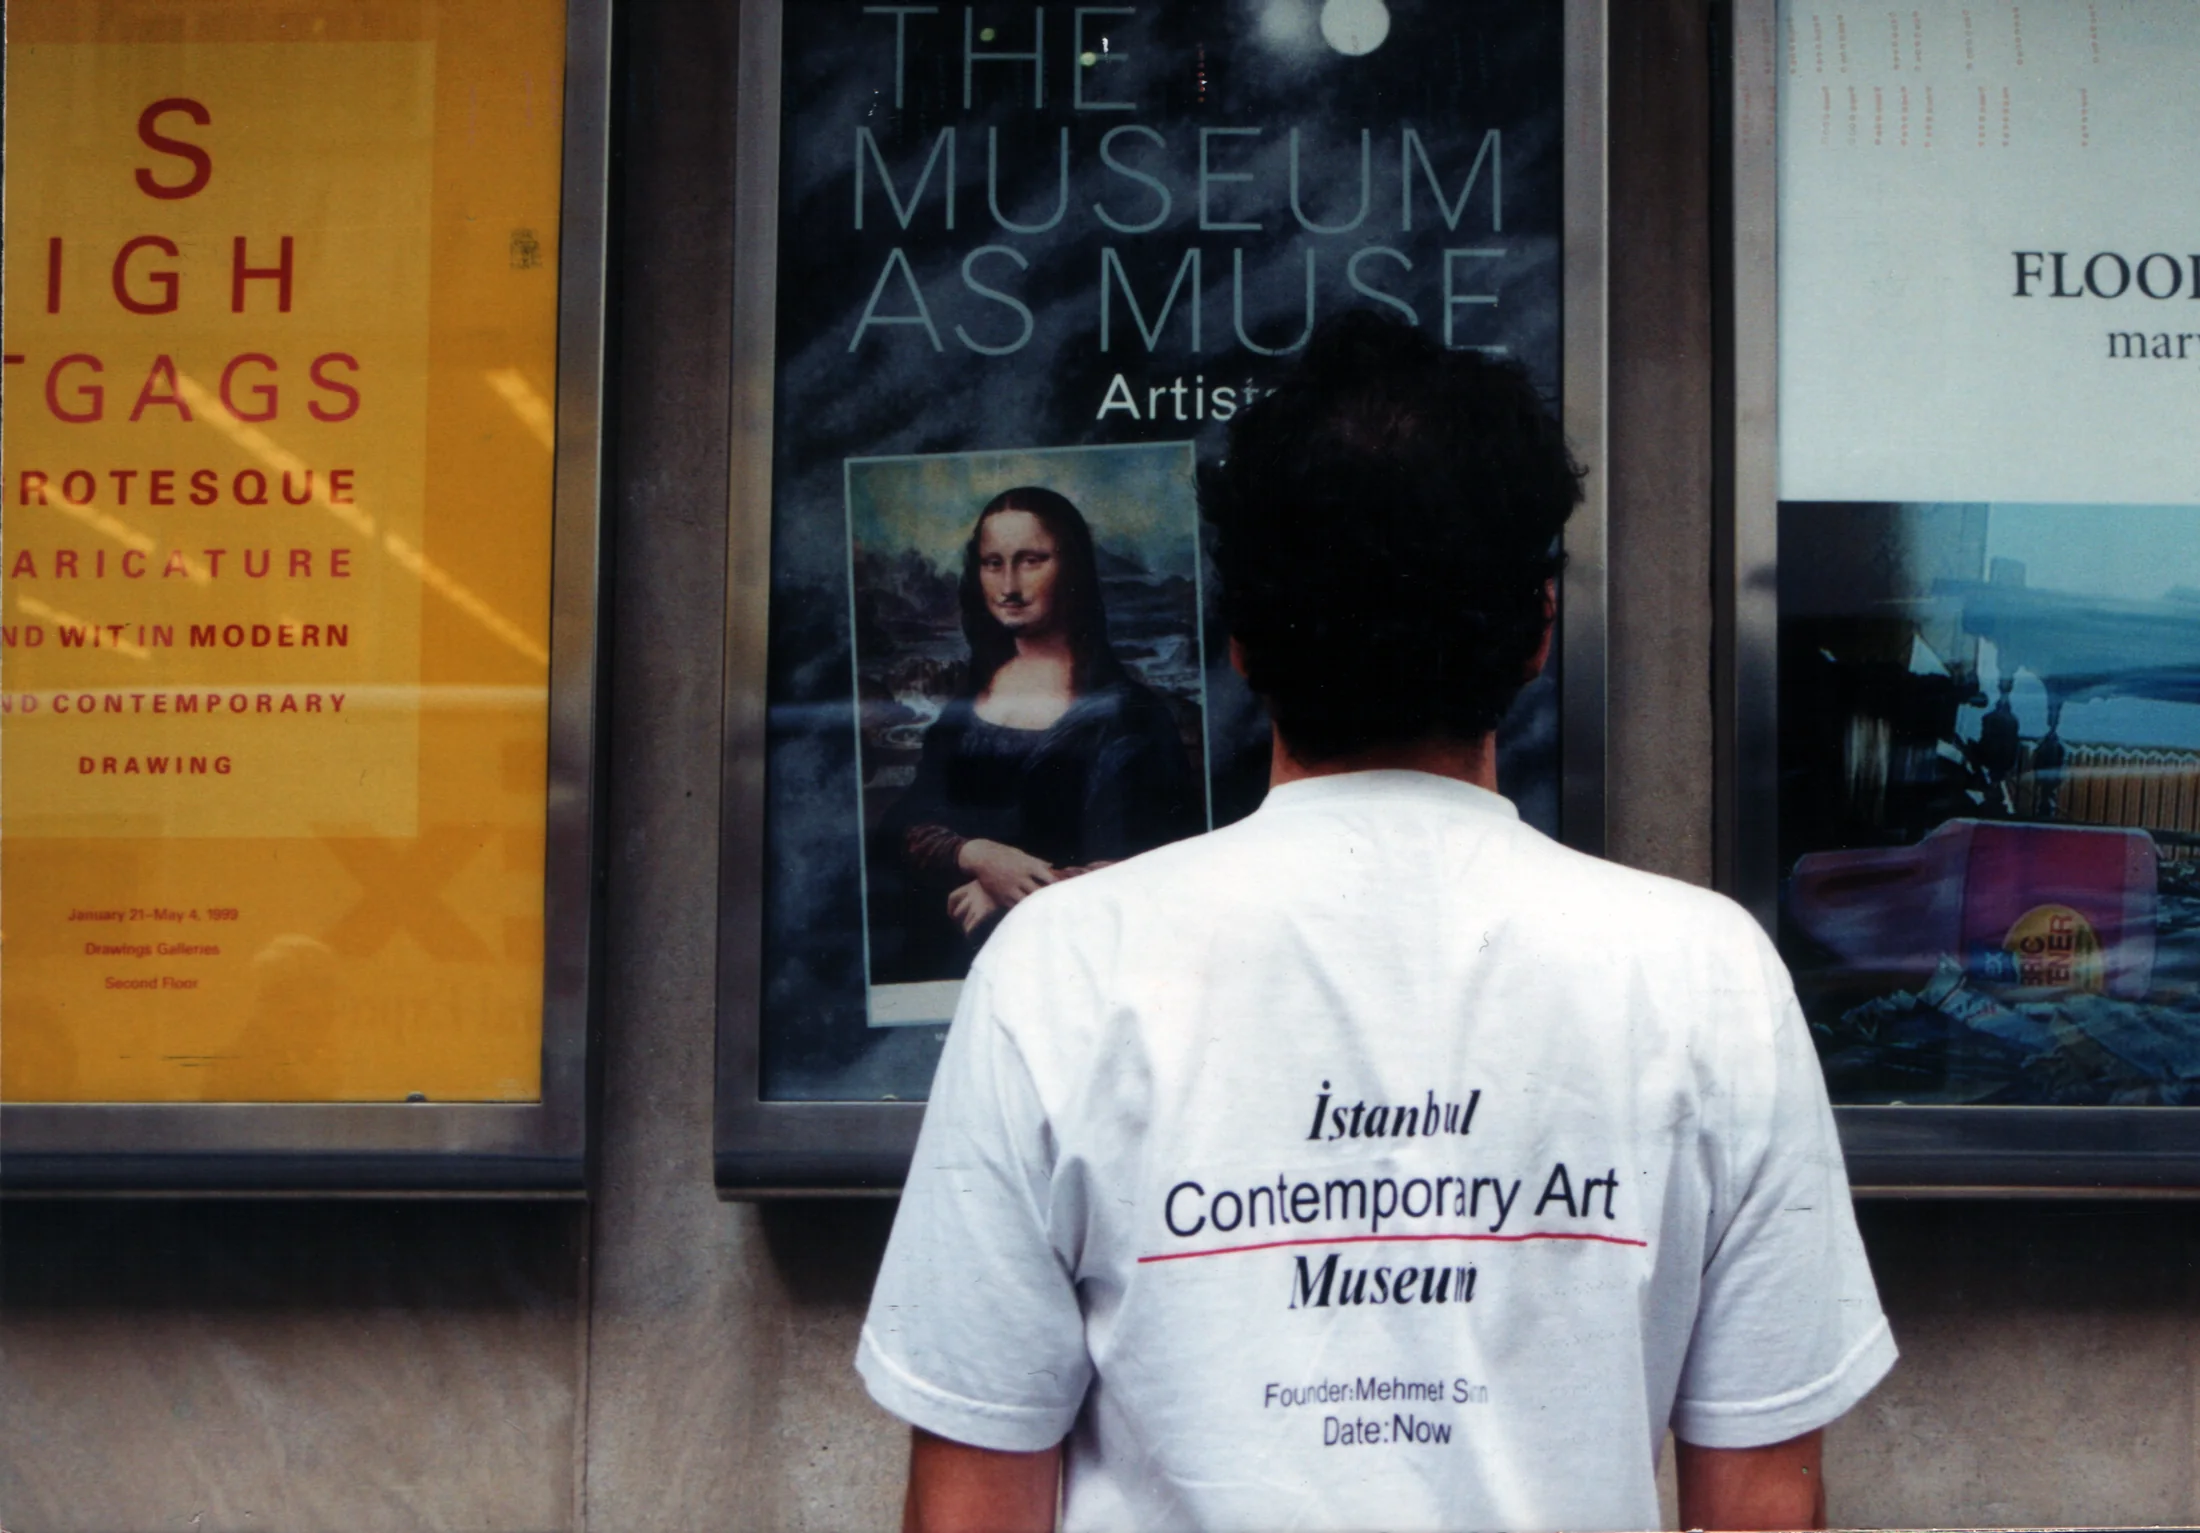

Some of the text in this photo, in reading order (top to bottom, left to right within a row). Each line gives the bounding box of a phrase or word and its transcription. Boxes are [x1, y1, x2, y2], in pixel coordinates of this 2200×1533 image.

[863, 5, 1137, 110] THE
[134, 97, 213, 200] S
[853, 124, 1502, 234] MUSEUM
[847, 245, 1507, 356] AS MUSE
[2107, 332, 2200, 360] mar
[1096, 373, 1278, 421] Artist
[3, 469, 355, 506] ROTESQUE
[59, 624, 125, 648] WIT
[138, 625, 174, 648] IN
[190, 624, 349, 648] MODERN
[52, 693, 346, 714] CONTEMPORARY
[78, 756, 232, 775] DRAWING
[68, 908, 126, 922] January
[206, 908, 239, 921] 1999
[85, 942, 221, 958] Drawings Galleries
[105, 976, 199, 990] Second Floor
[1164, 1162, 1619, 1238] Contemporary Art
[1287, 1252, 1478, 1310] Museum
